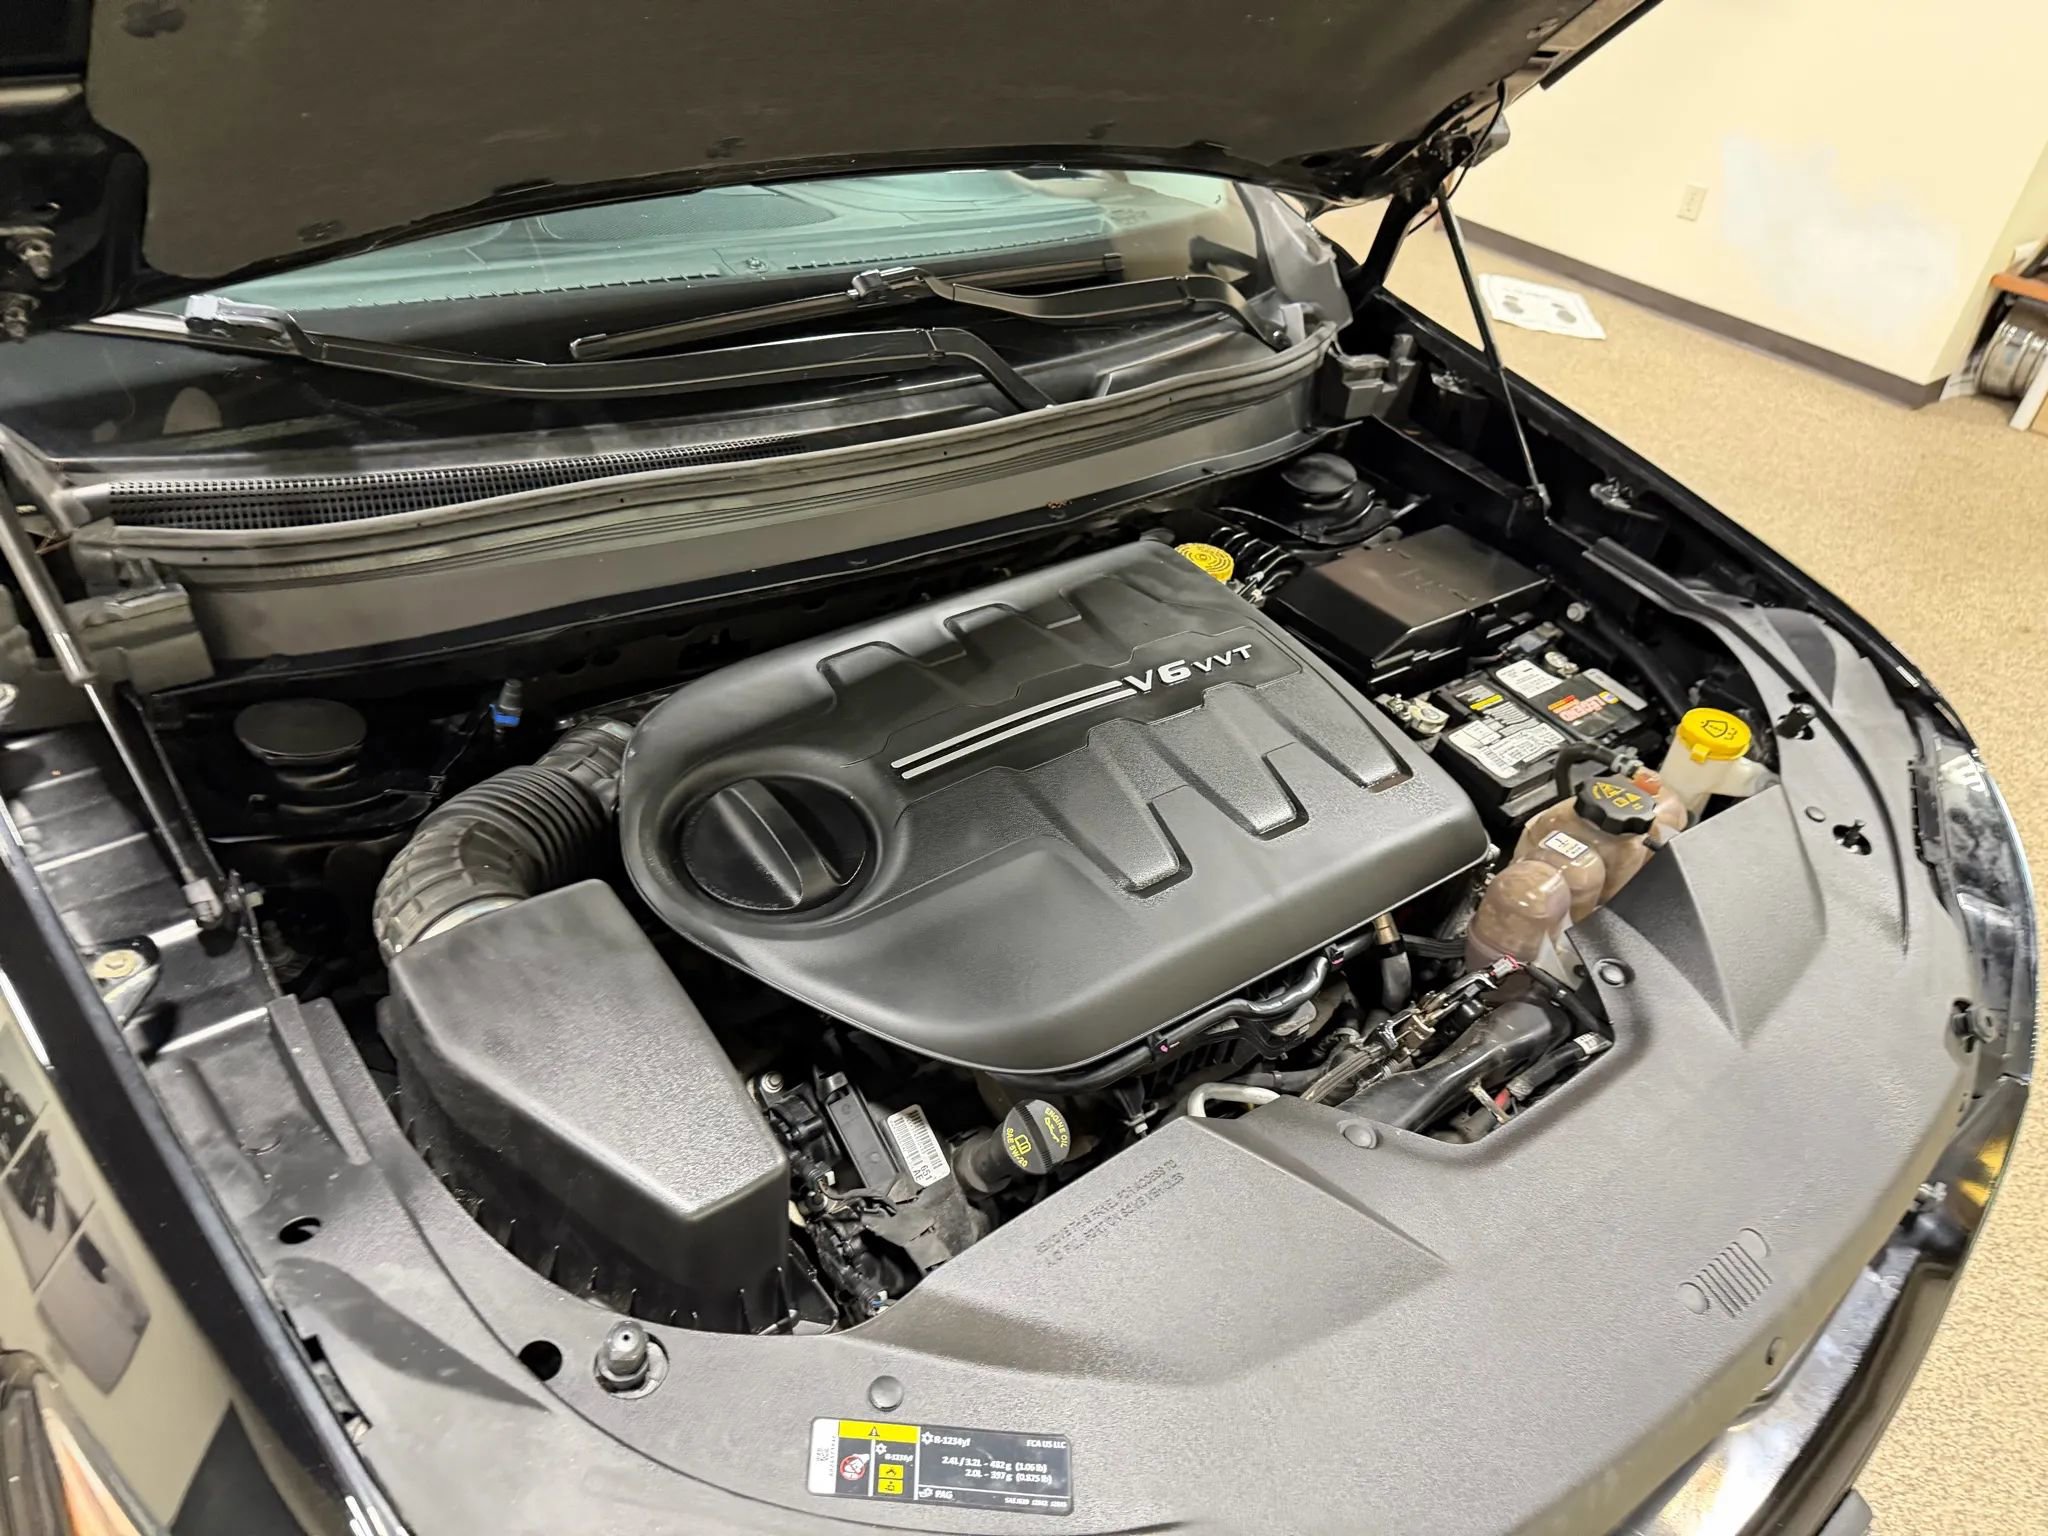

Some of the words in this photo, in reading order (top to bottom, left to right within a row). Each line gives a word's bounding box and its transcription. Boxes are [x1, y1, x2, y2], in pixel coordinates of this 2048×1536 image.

[1122, 660, 1192, 692] V6
[1191, 644, 1252, 672] VVT
[1006, 1127, 1015, 1144] SAE
[1044, 1107, 1066, 1133] ENGINE
[1060, 1134, 1069, 1148] OIL
[1009, 1144, 1028, 1168] 5W-20
